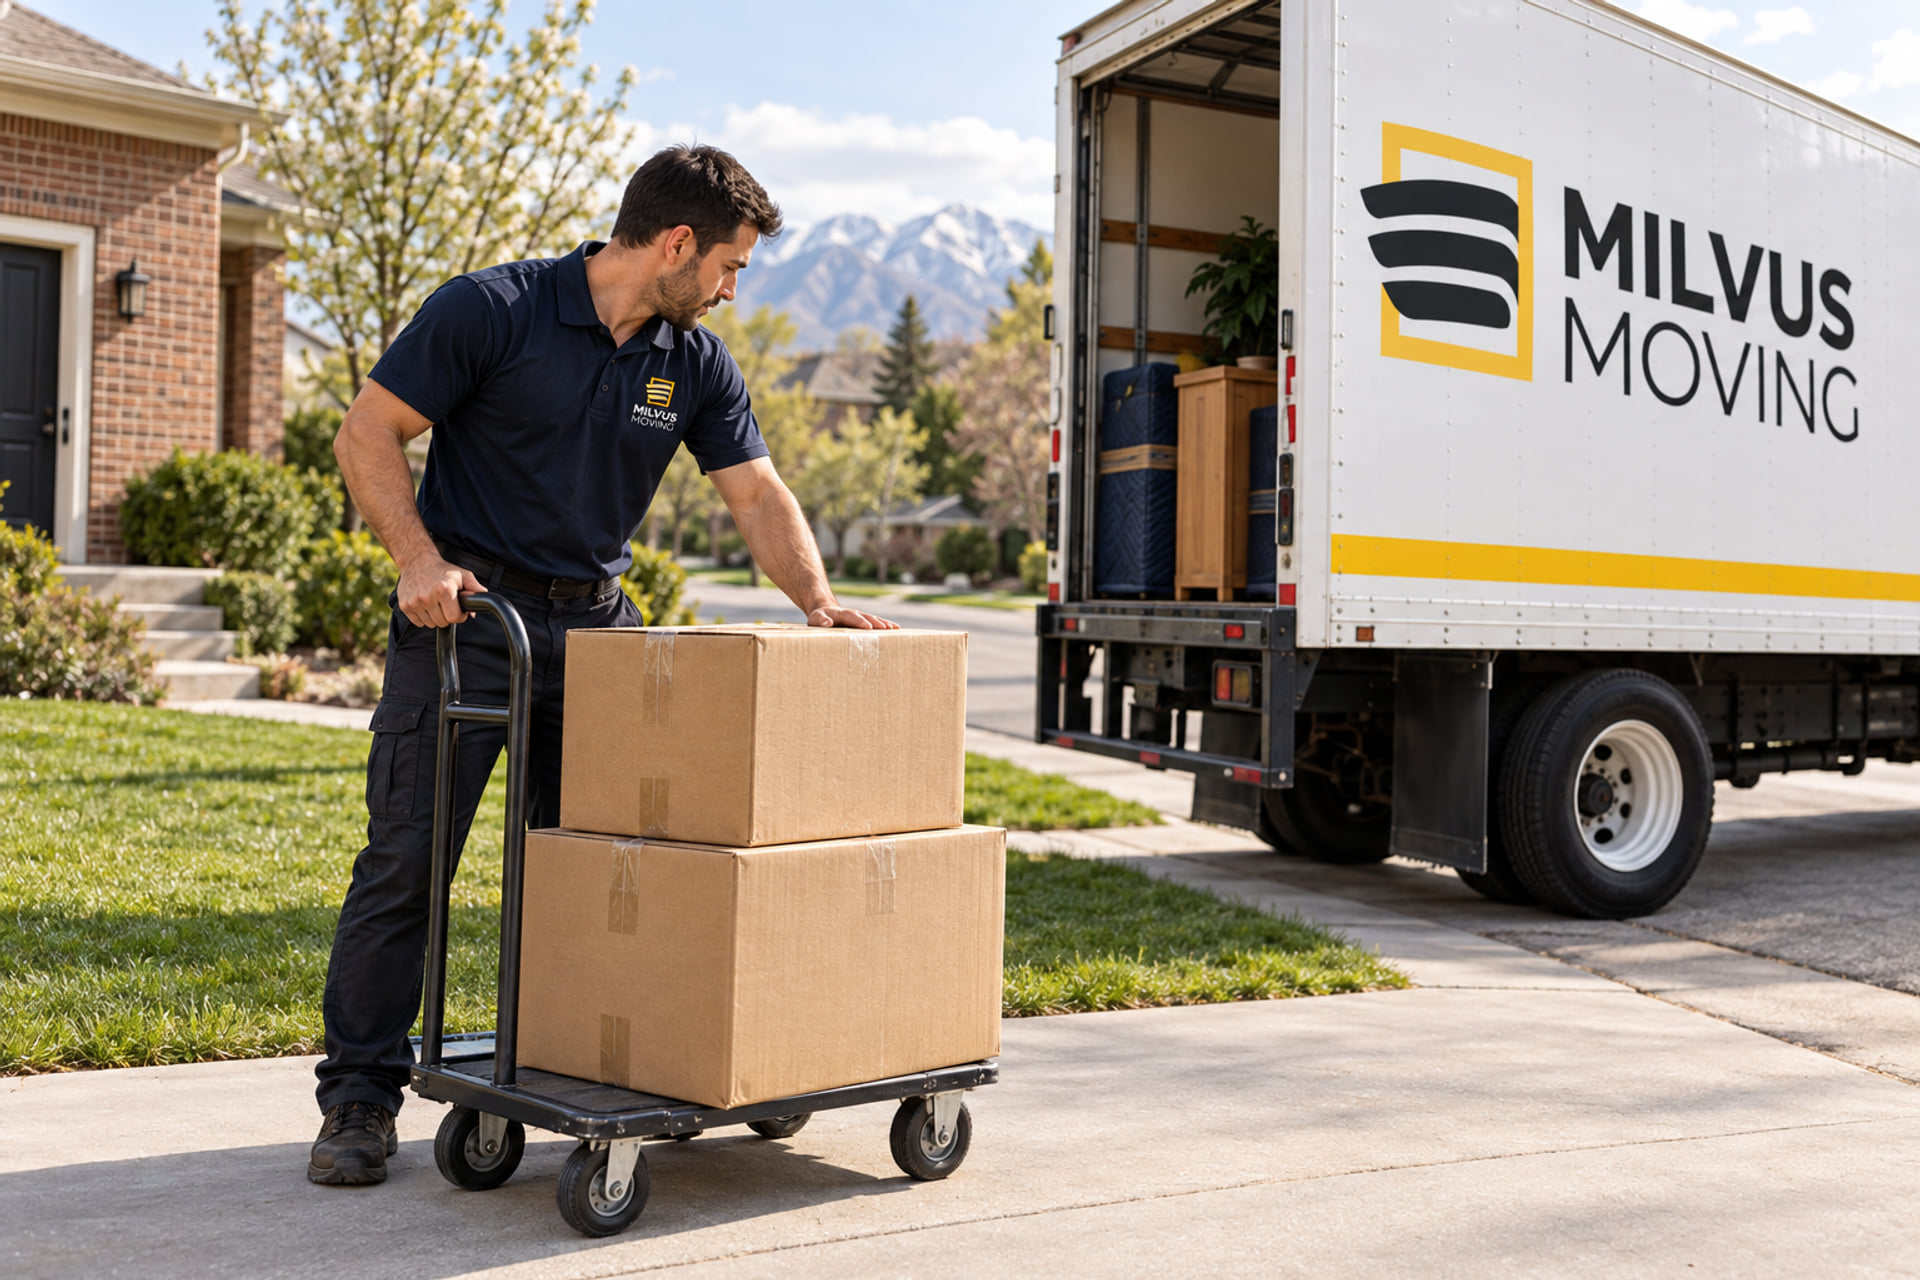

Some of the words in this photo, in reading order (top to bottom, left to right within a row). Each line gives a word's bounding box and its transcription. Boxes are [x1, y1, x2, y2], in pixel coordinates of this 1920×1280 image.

[1564, 185, 1855, 351] MILVUS
[1564, 296, 1859, 443] MOVING
[631, 415, 675, 432] MOVING
[633, 403, 678, 423] MILVUS
